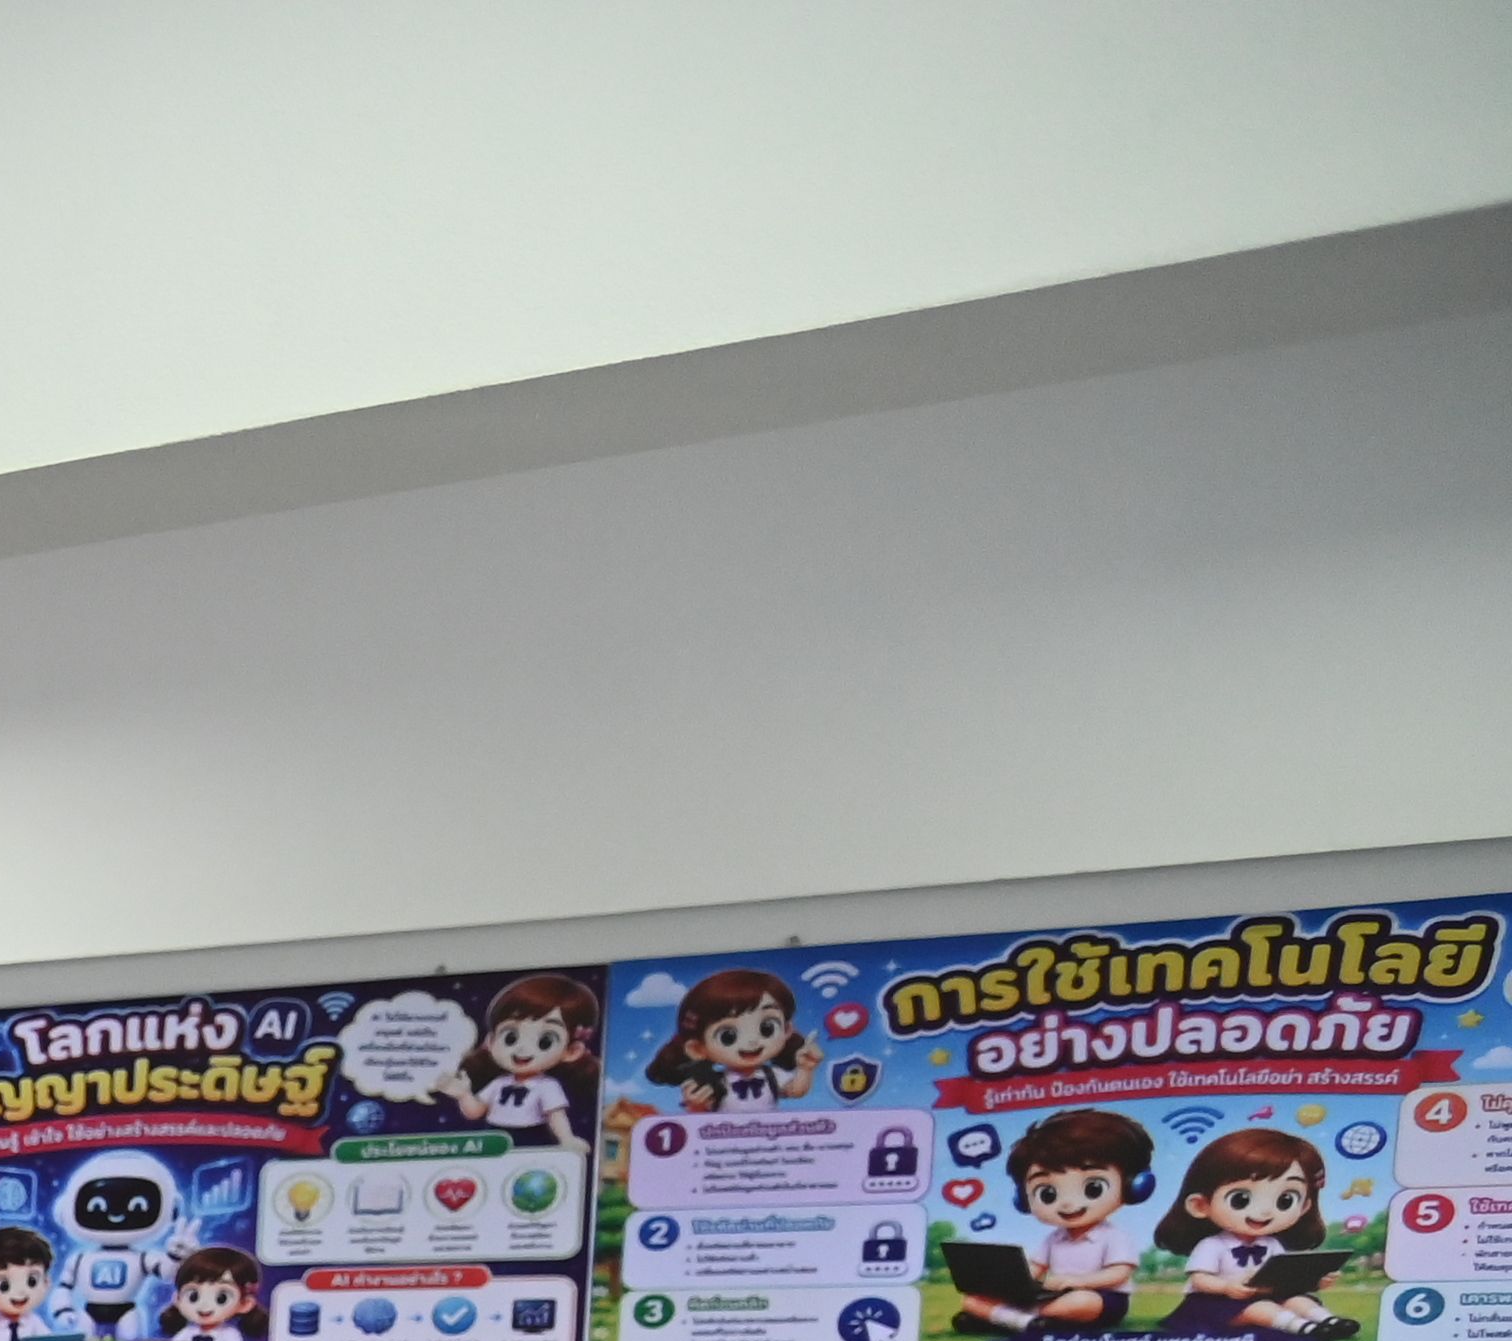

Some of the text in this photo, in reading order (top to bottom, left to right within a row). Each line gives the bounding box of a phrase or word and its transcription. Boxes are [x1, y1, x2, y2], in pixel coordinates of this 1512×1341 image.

[892, 918, 1490, 1028] การใช้เทคโนโลยี
[14, 1003, 298, 1066] โลกแห่ง AI
[975, 996, 1413, 1074] อย่างปลอดภัย
[983, 1083, 1046, 1110] รู้เท่าทัน
[1051, 1075, 1164, 1098] ป้องกันตนเอง
[1307, 1069, 1401, 1086] สร้างสรรค์
[1424, 1099, 1453, 1125] 4
[462, 1140, 483, 1153] AI
[657, 1127, 673, 1151] 1
[1416, 1200, 1440, 1226] 5
[647, 1220, 670, 1246] 2
[95, 1263, 124, 1286] AI
[330, 1273, 351, 1288] AI
[643, 1300, 665, 1323] 3
[1405, 1293, 1430, 1319] 6
